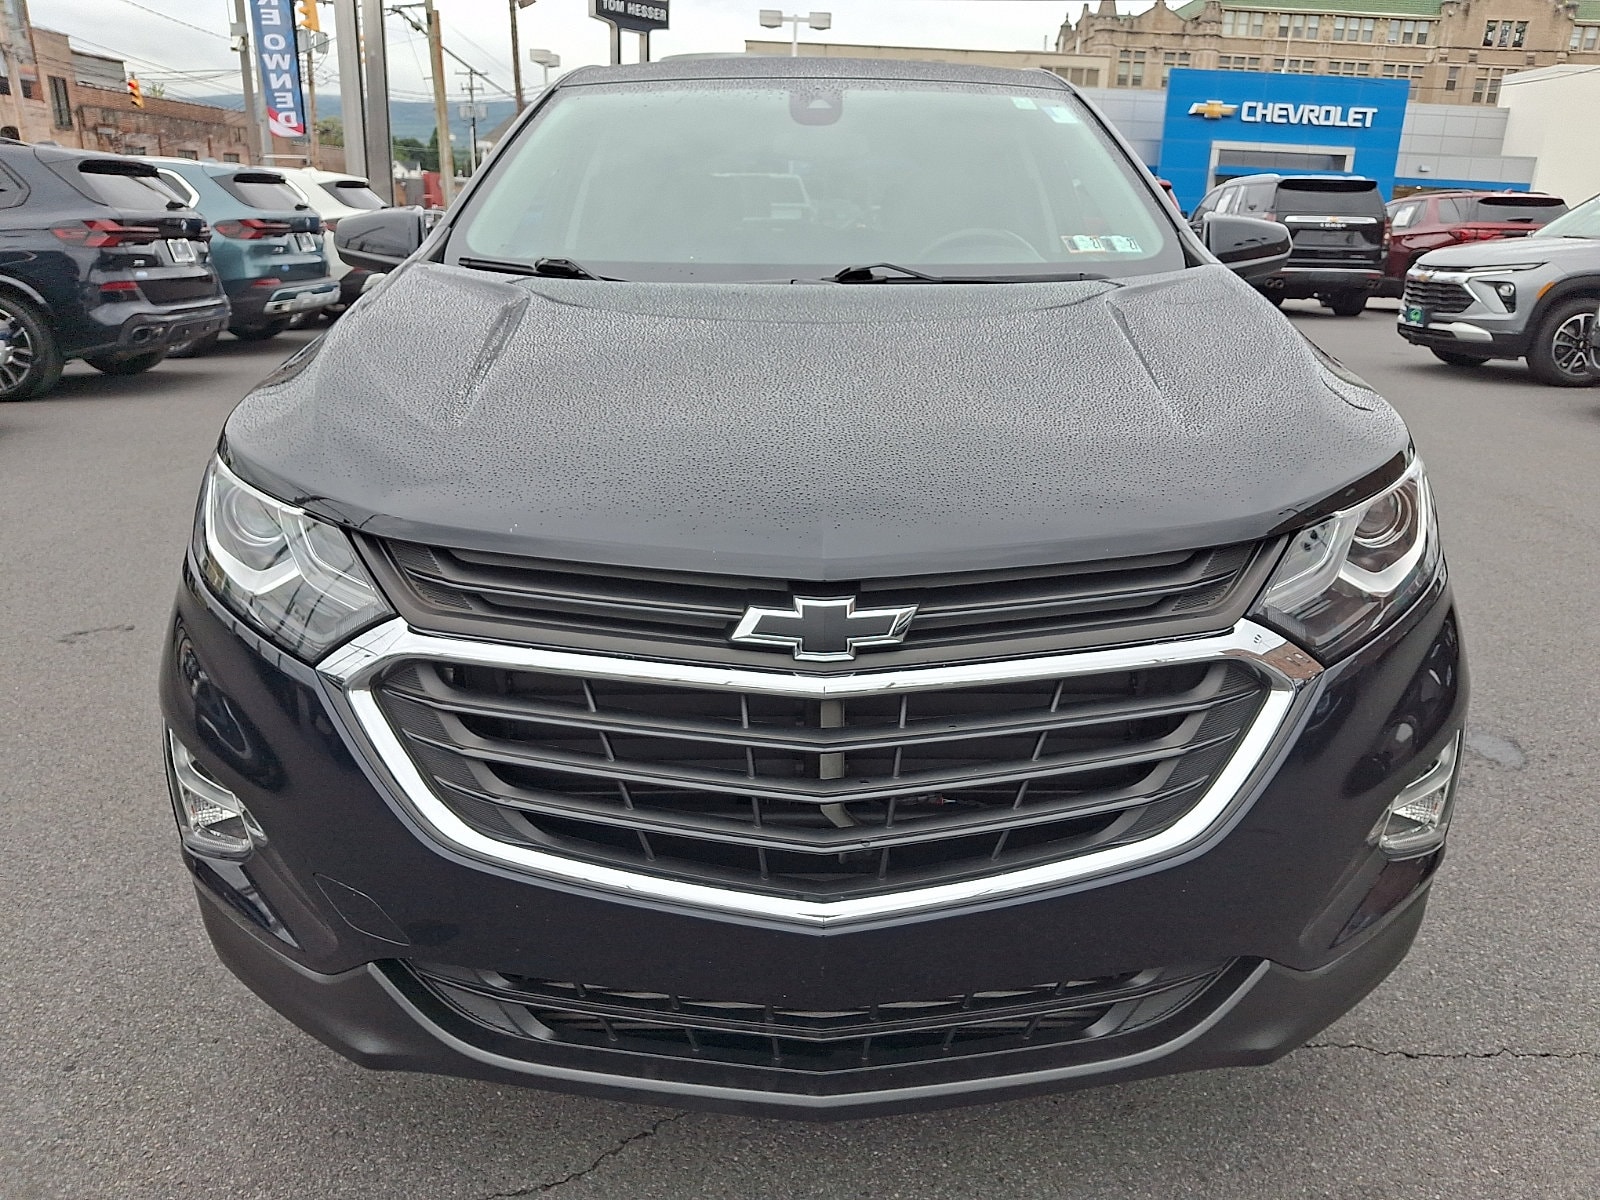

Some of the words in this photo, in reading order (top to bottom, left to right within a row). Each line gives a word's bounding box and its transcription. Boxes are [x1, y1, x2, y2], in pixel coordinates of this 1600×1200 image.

[602, 0, 625, 13] TOM
[627, 2, 667, 21] HESSER
[1241, 101, 1378, 128] CHEVROLET
